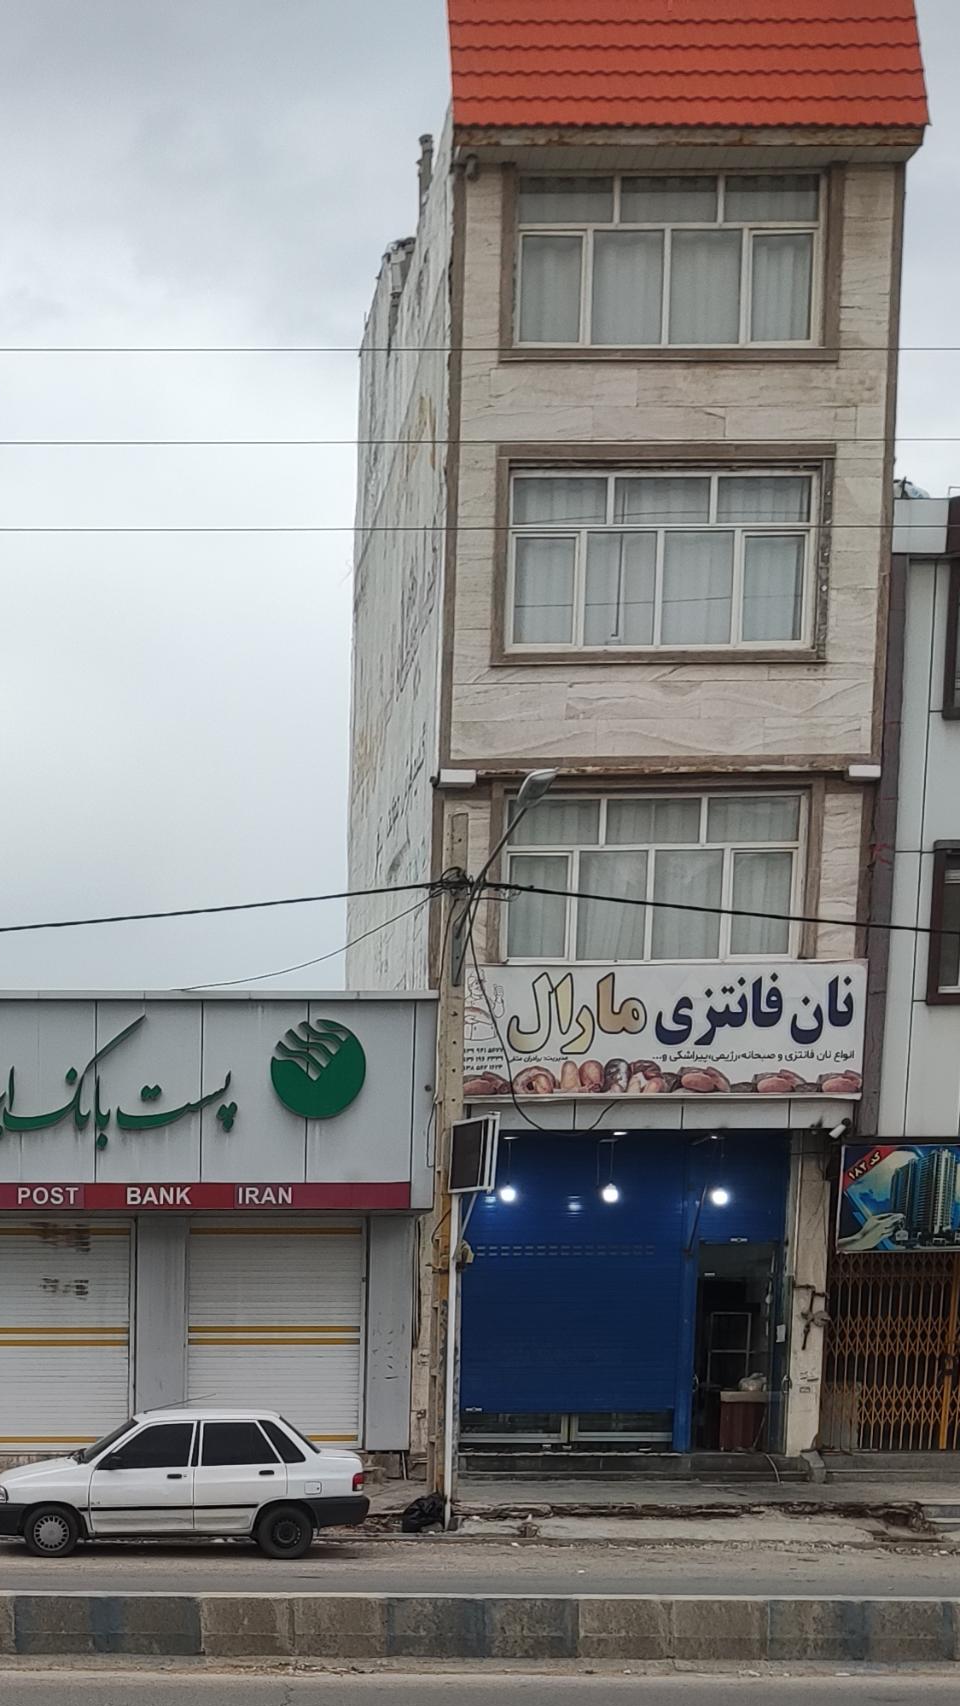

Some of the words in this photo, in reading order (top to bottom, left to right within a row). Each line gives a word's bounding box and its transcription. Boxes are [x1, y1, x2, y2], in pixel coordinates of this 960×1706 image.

[507, 972, 647, 1054] مارال
[655, 972, 784, 1046] فانتزی
[789, 975, 855, 1045] نان
[3, 1014, 146, 1150] بانک
[784, 1050, 815, 1062] فانتزی
[817, 1051, 832, 1061] نان
[834, 1050, 855, 1062] انواع
[117, 1070, 238, 1132] پست
[17, 1187, 79, 1205] POST
[126, 1187, 192, 1205] BANK
[238, 1187, 293, 1205] IRAN
